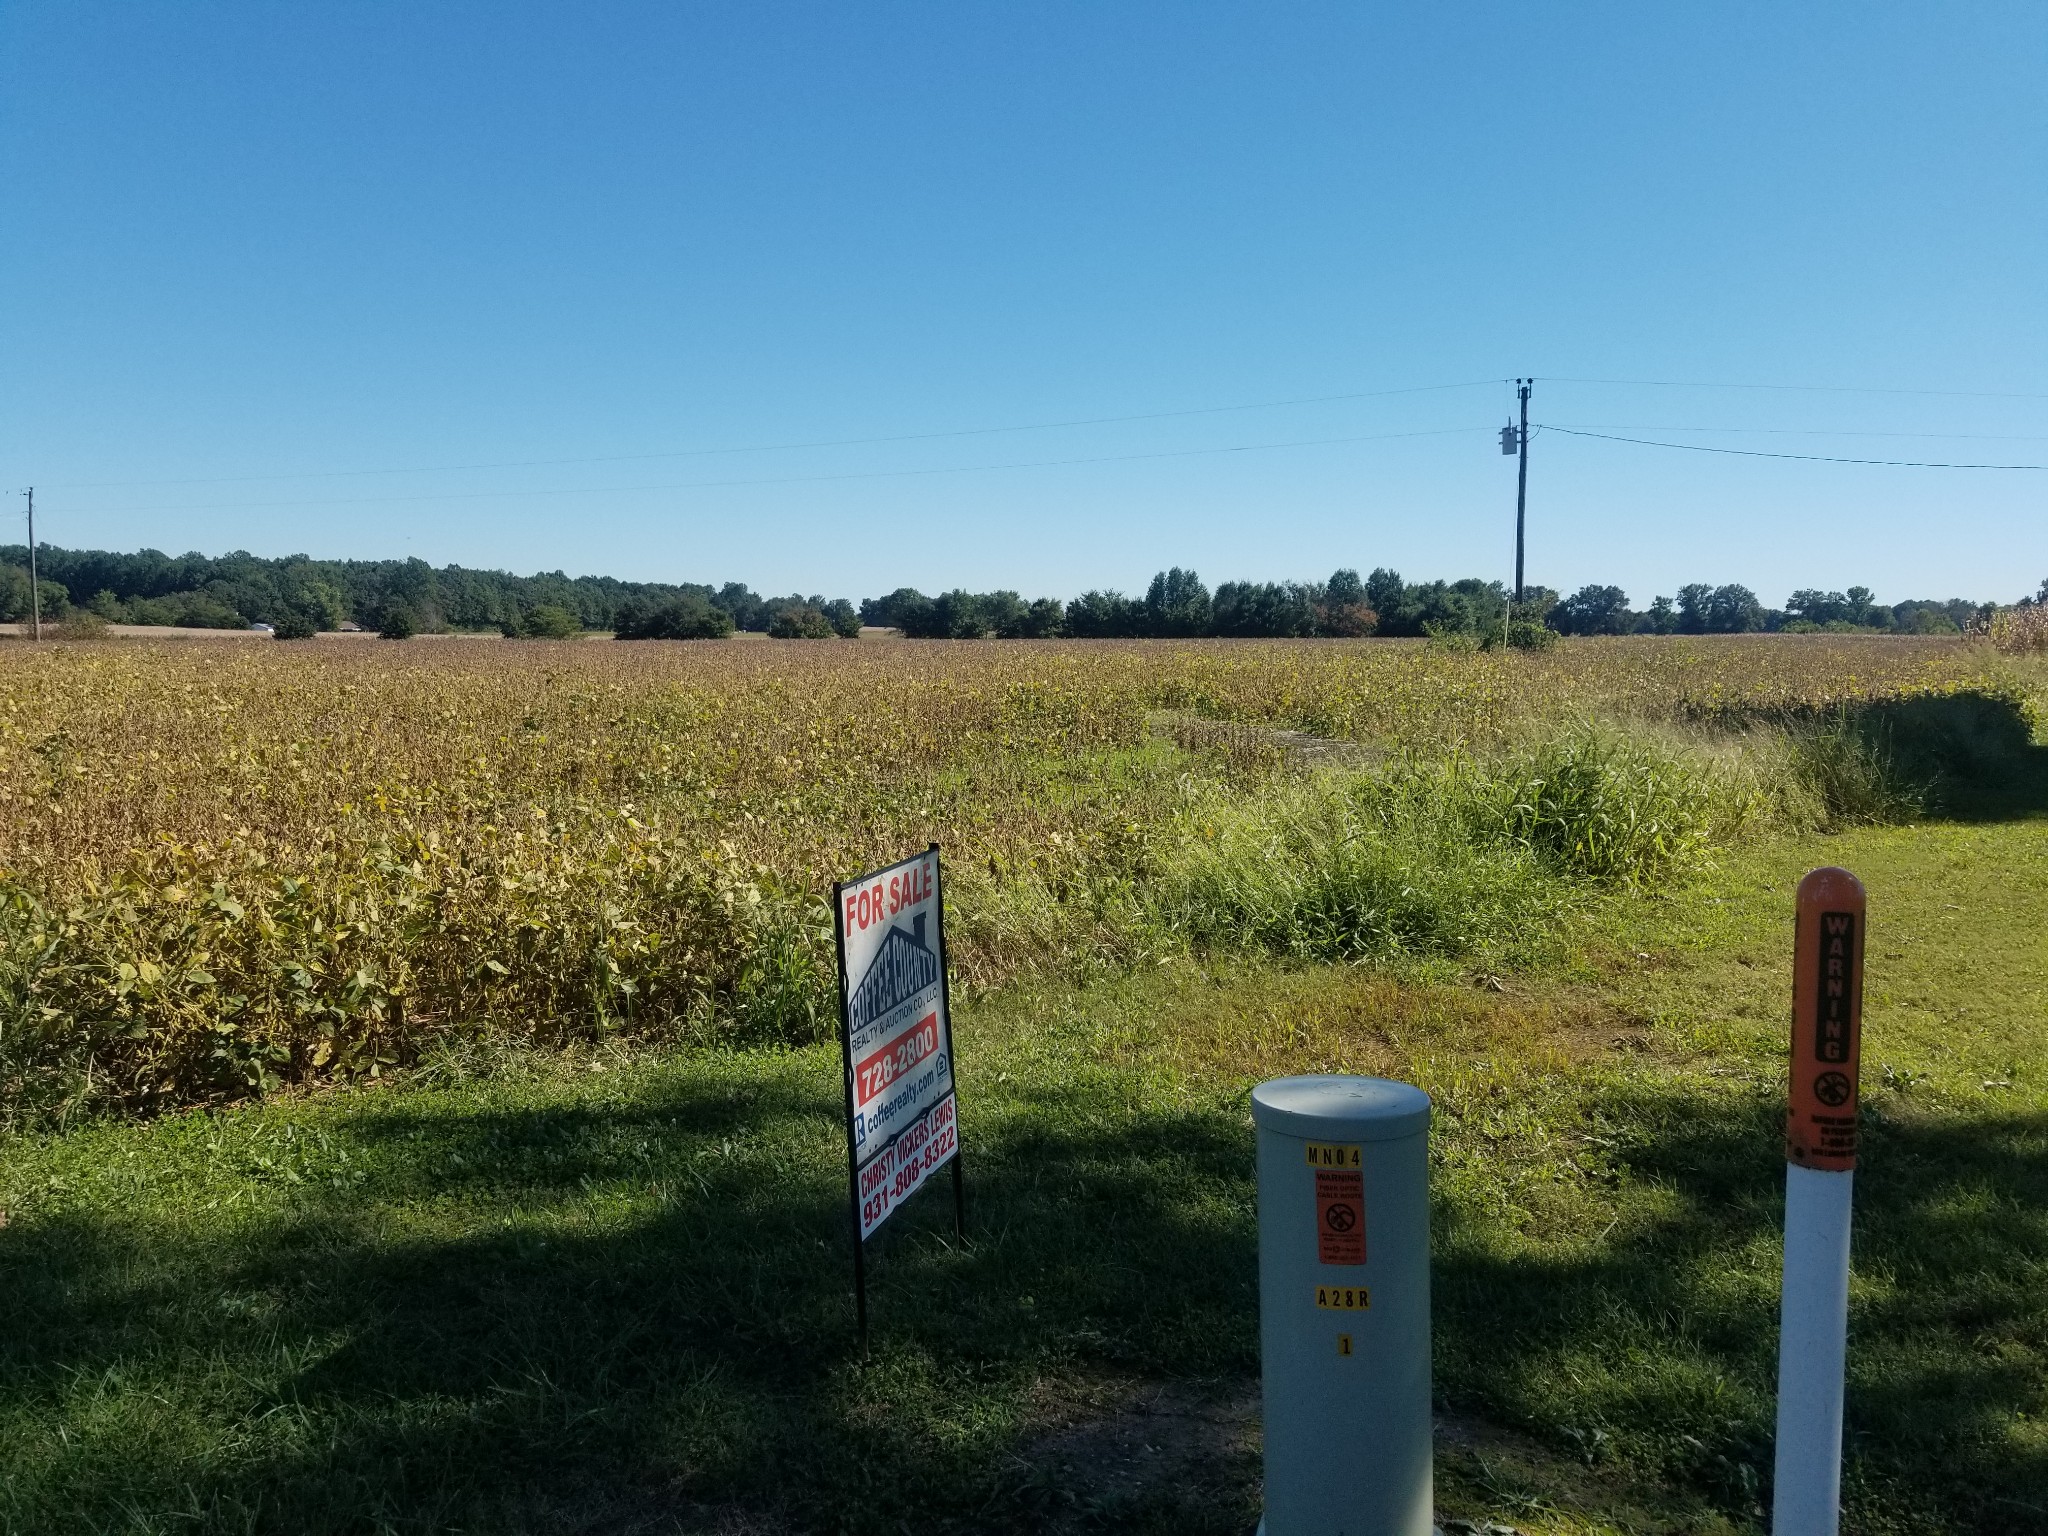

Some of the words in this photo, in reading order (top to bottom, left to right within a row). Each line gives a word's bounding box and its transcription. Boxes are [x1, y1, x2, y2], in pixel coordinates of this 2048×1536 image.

[846, 884, 884, 937] FOR
[889, 862, 932, 915] SALE
[851, 939, 893, 1029] COFFEE
[892, 934, 935, 998] COUNTY
[1824, 916, 1848, 1060] WARNING
[852, 1026, 878, 1051] REALTY
[879, 1022, 885, 1034] &
[885, 1004, 913, 1029] AUCTION
[926, 987, 937, 1005] LLC
[862, 1025, 934, 1099] 728-2800
[868, 1068, 934, 1134] coffeerealty.com
[861, 1151, 896, 1199] CHRISTY
[897, 1118, 929, 1166] VICKERS
[930, 1099, 953, 1139] LEWIS
[863, 1125, 955, 1228] 931-808-8322
[1317, 1173, 1361, 1182] WARNING
[1318, 1289, 1369, 1307] A28R
[1342, 1338, 1350, 1354] 1
